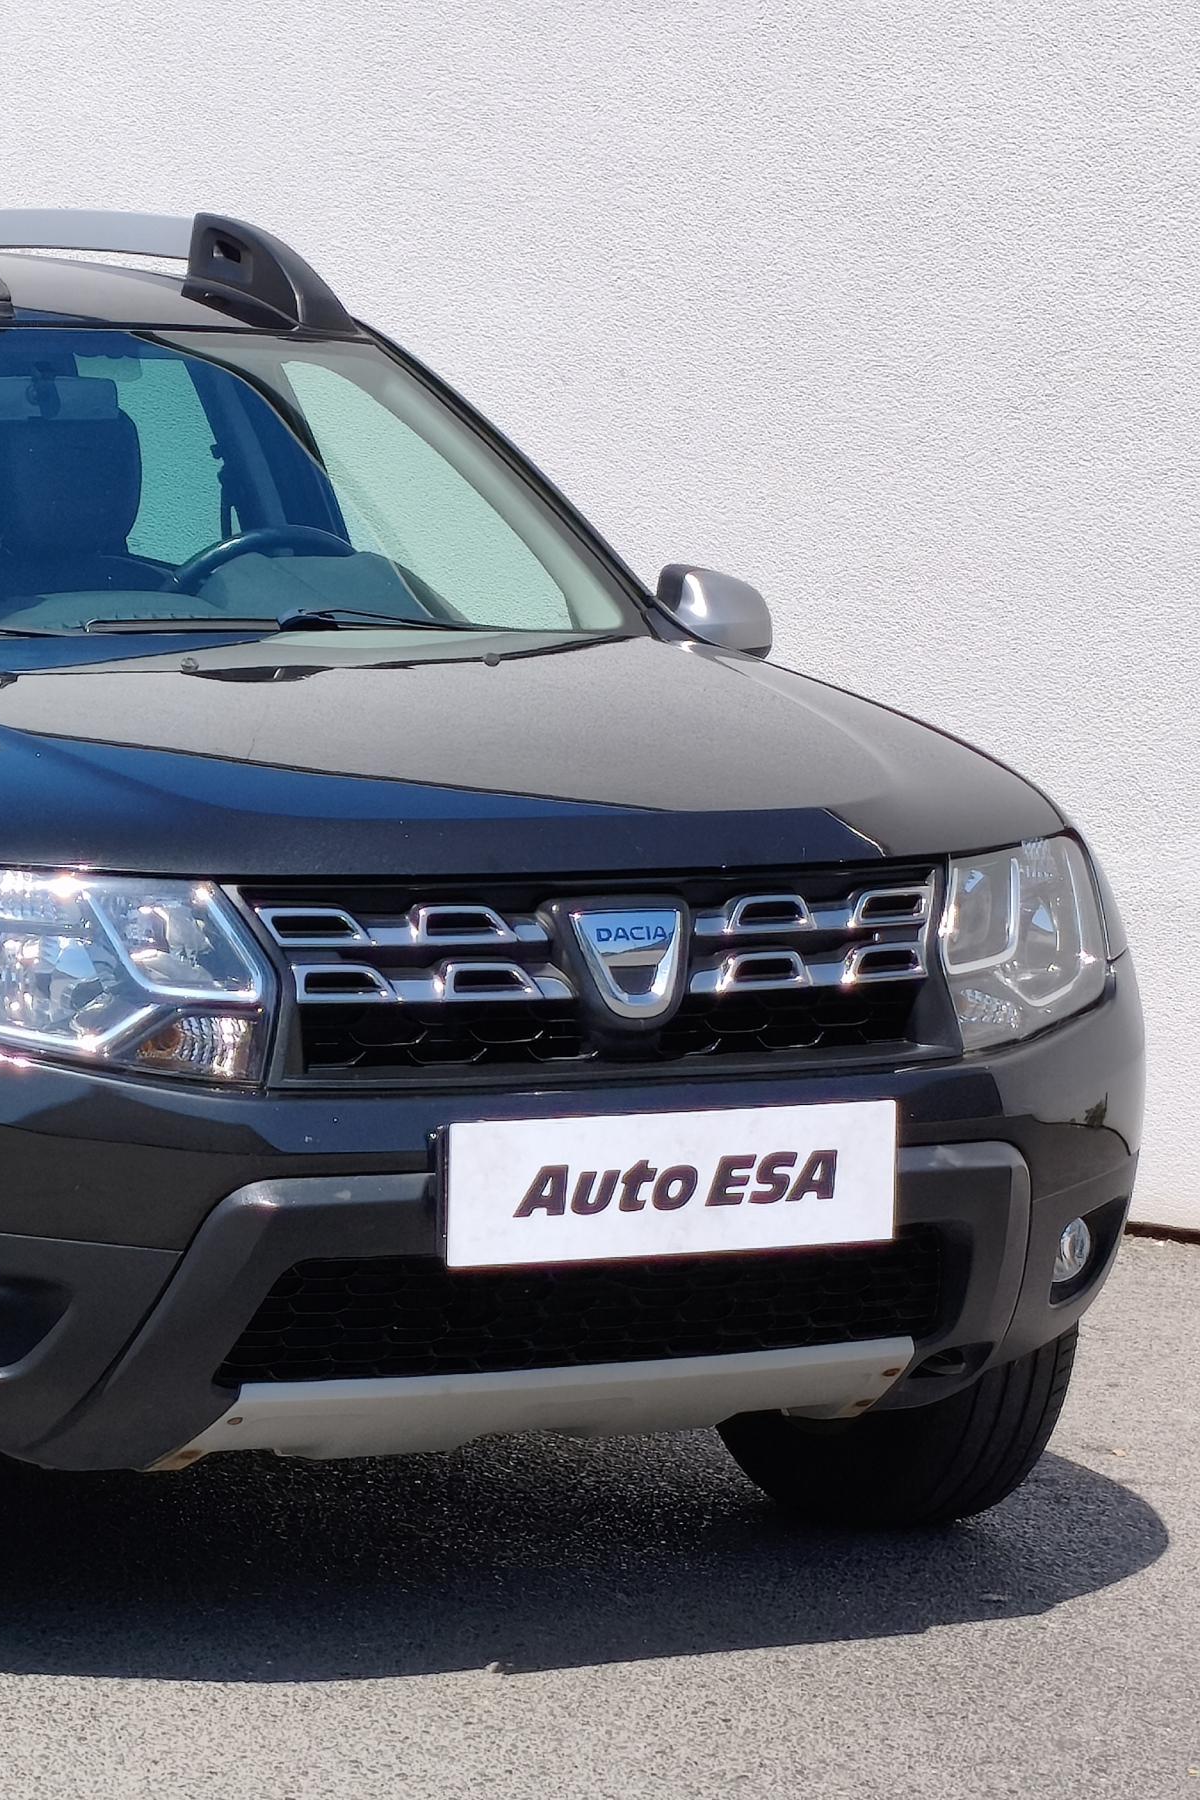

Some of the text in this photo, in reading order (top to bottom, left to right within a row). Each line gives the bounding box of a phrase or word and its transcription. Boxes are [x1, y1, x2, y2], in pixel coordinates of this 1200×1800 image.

[596, 926, 667, 942] DACIA
[513, 1150, 838, 1217] Auto ESA
